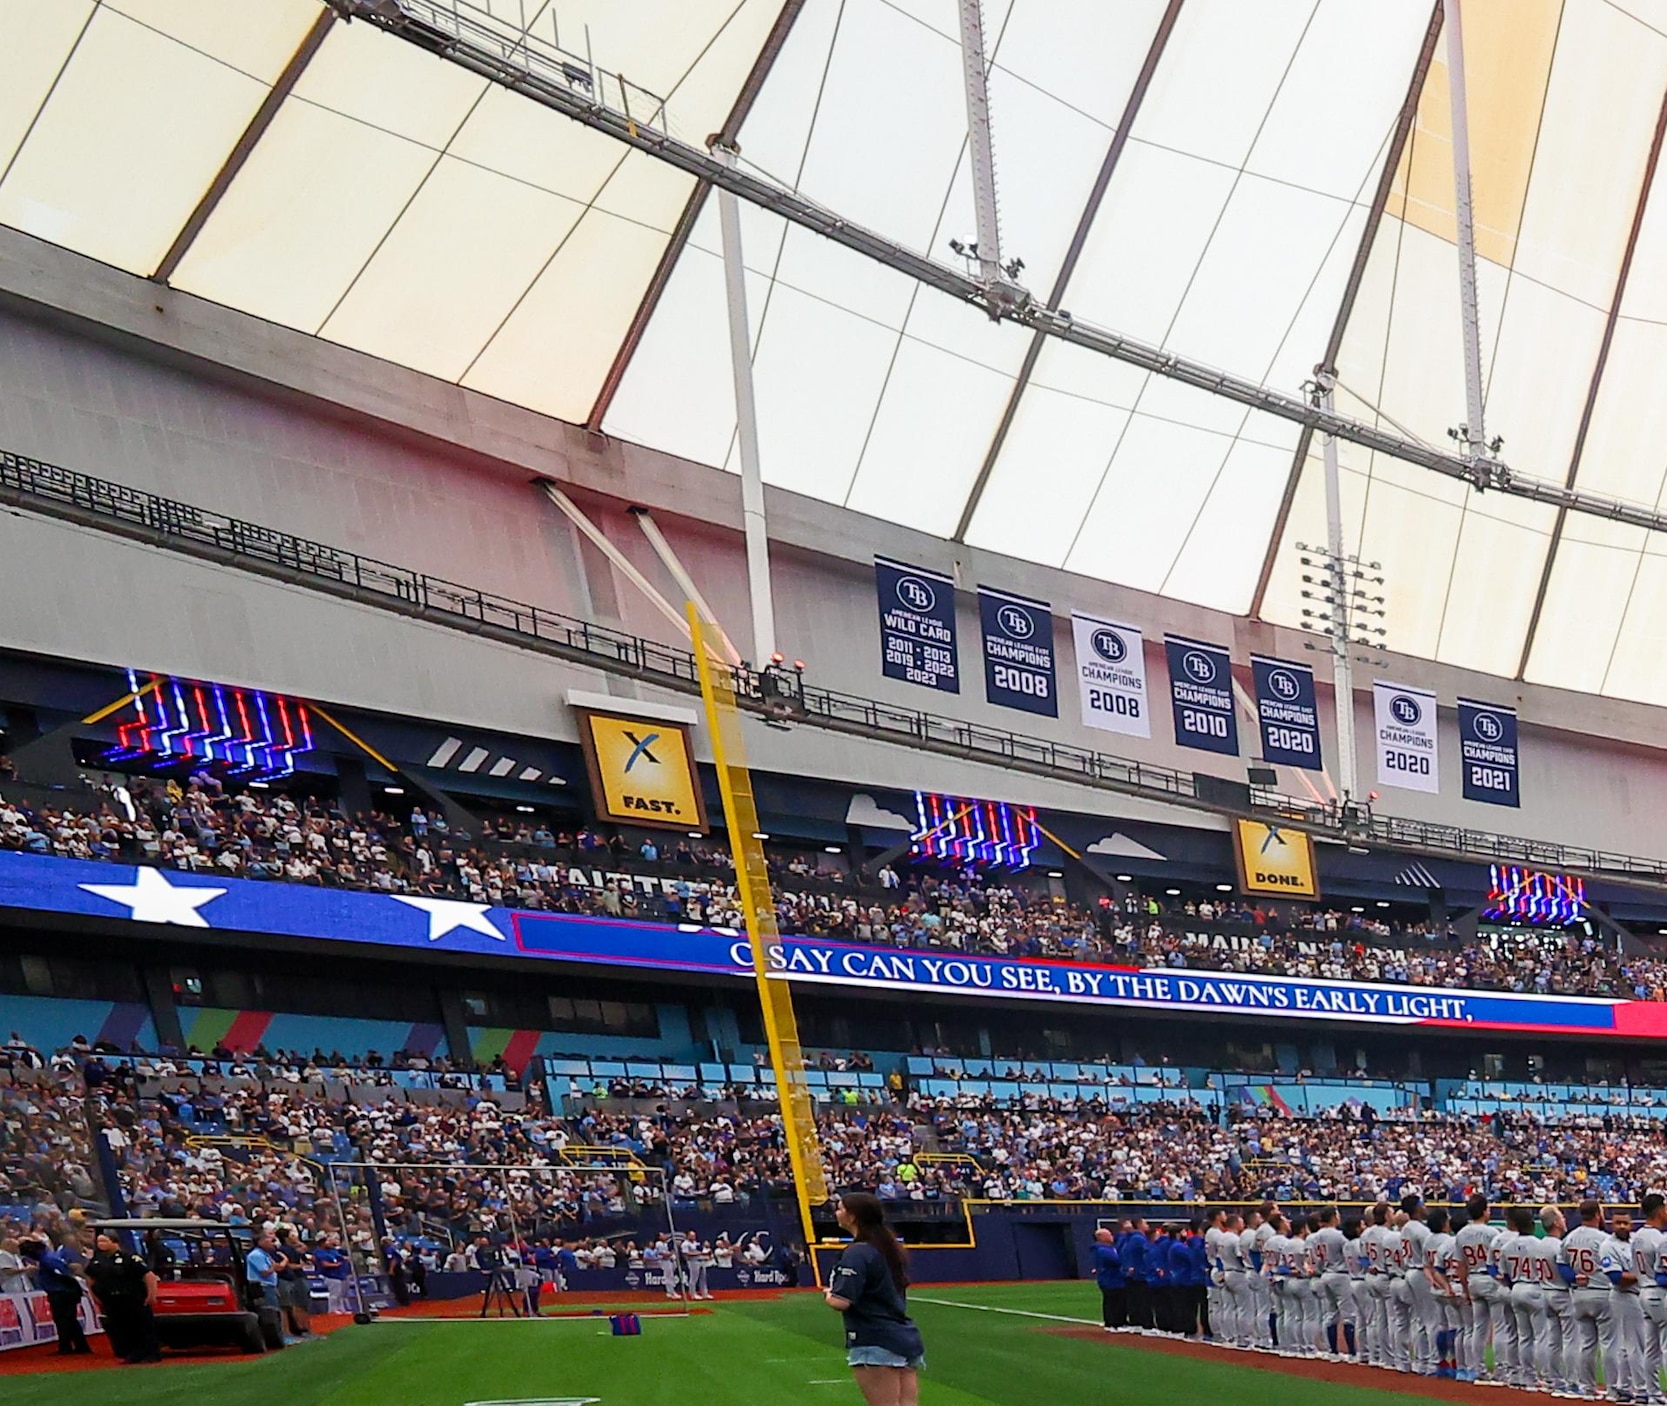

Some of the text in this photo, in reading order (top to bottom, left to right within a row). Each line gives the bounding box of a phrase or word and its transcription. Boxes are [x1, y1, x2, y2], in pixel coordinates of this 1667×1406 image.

[884, 613, 951, 643] WILD CARD
[888, 637, 951, 663] 2011 2013
[986, 641, 1051, 668] CHAMPIONS
[886, 650, 955, 678] 2019 2022
[906, 667, 937, 686] 2023
[994, 665, 1048, 698] 2008
[1082, 665, 1142, 690] CHAMPIONS
[1089, 689, 1140, 719] 2008
[1174, 686, 1232, 710] CHAMPIONS
[1183, 709, 1228, 738] 2010
[1260, 703, 1315, 726] CHAMPIONS
[1268, 727, 1314, 754] 2020
[1380, 729, 1433, 750] CHAMPIONS
[1386, 750, 1430, 775] 2020
[1463, 746, 1516, 766] CHAMPIONS
[1471, 766, 1510, 792] 2021
[622, 795, 681, 816] FAST.
[1255, 872, 1304, 887] DONE.
[769, 945, 833, 973] SAY
[842, 952, 916, 981] CAN
[919, 959, 992, 988] YOU
[1001, 966, 1061, 995] SEE,
[1067, 971, 1104, 995] BY
[1110, 974, 1171, 1001] THE
[1178, 981, 1289, 1009] DAWN'S
[1296, 988, 1380, 1015] EARLY
[1387, 995, 1474, 1023] LIGHT,
[1566, 1248, 1595, 1273] 76
